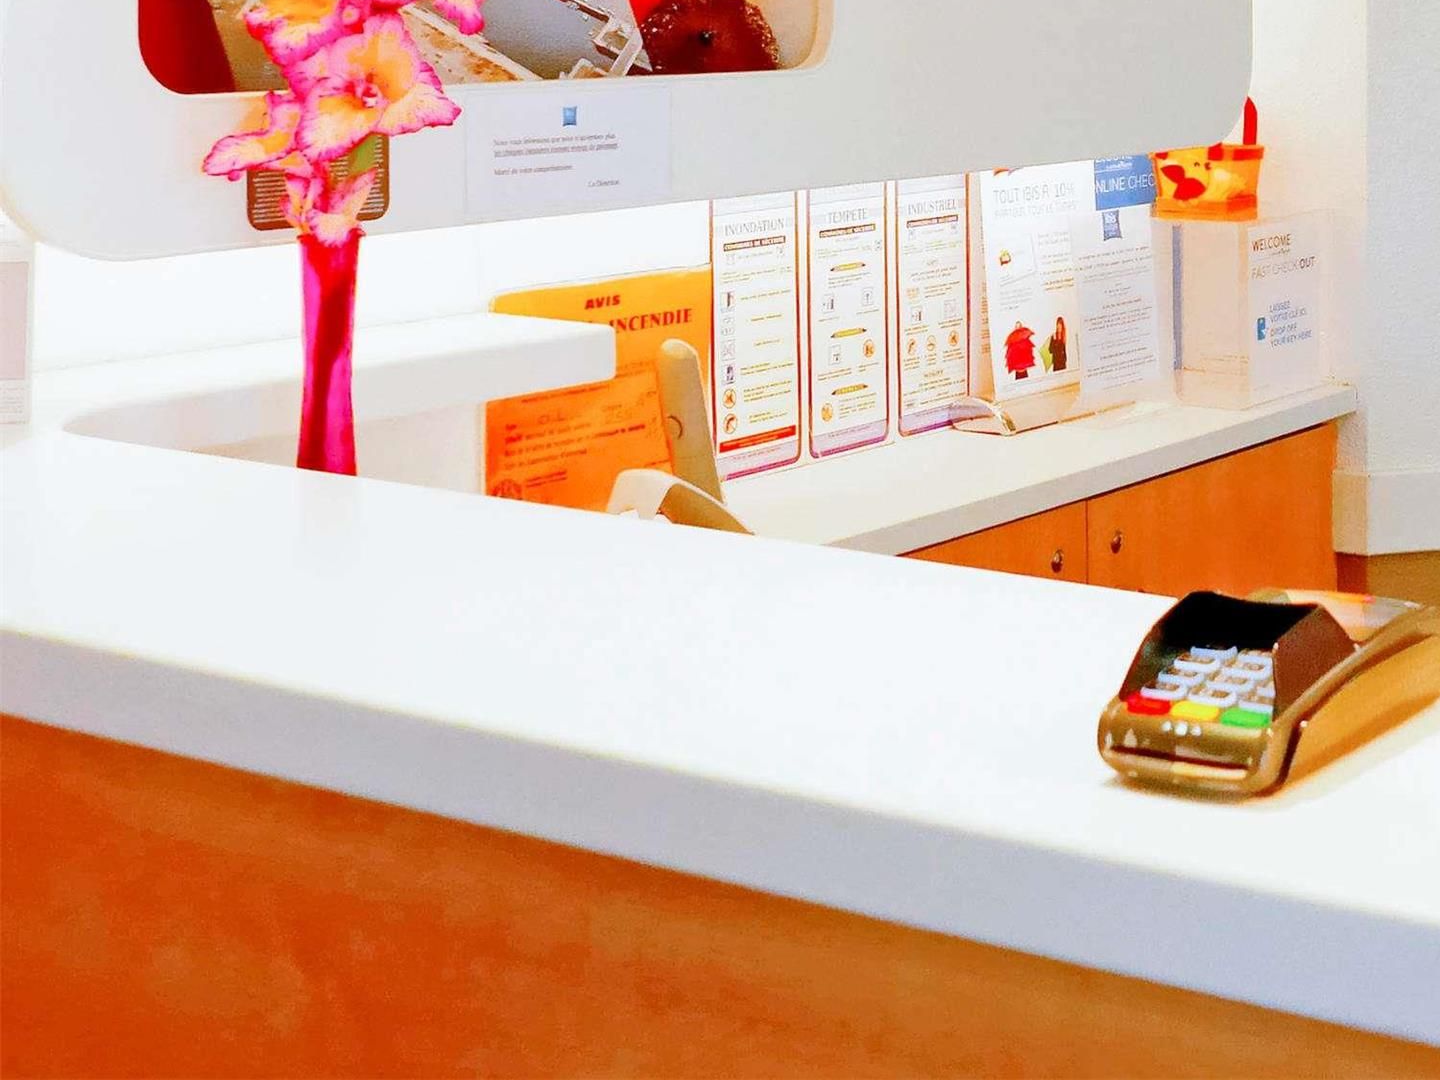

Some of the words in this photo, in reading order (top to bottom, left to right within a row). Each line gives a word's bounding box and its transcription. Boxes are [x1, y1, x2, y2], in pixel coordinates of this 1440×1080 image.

[1095, 176, 1126, 194] NLINE
[1127, 173, 1156, 190] CHEC
[725, 218, 785, 236] INONDATION
[1252, 233, 1291, 252] WELCOME
[1299, 256, 1316, 270] OUT
[584, 294, 620, 310] AVIS
